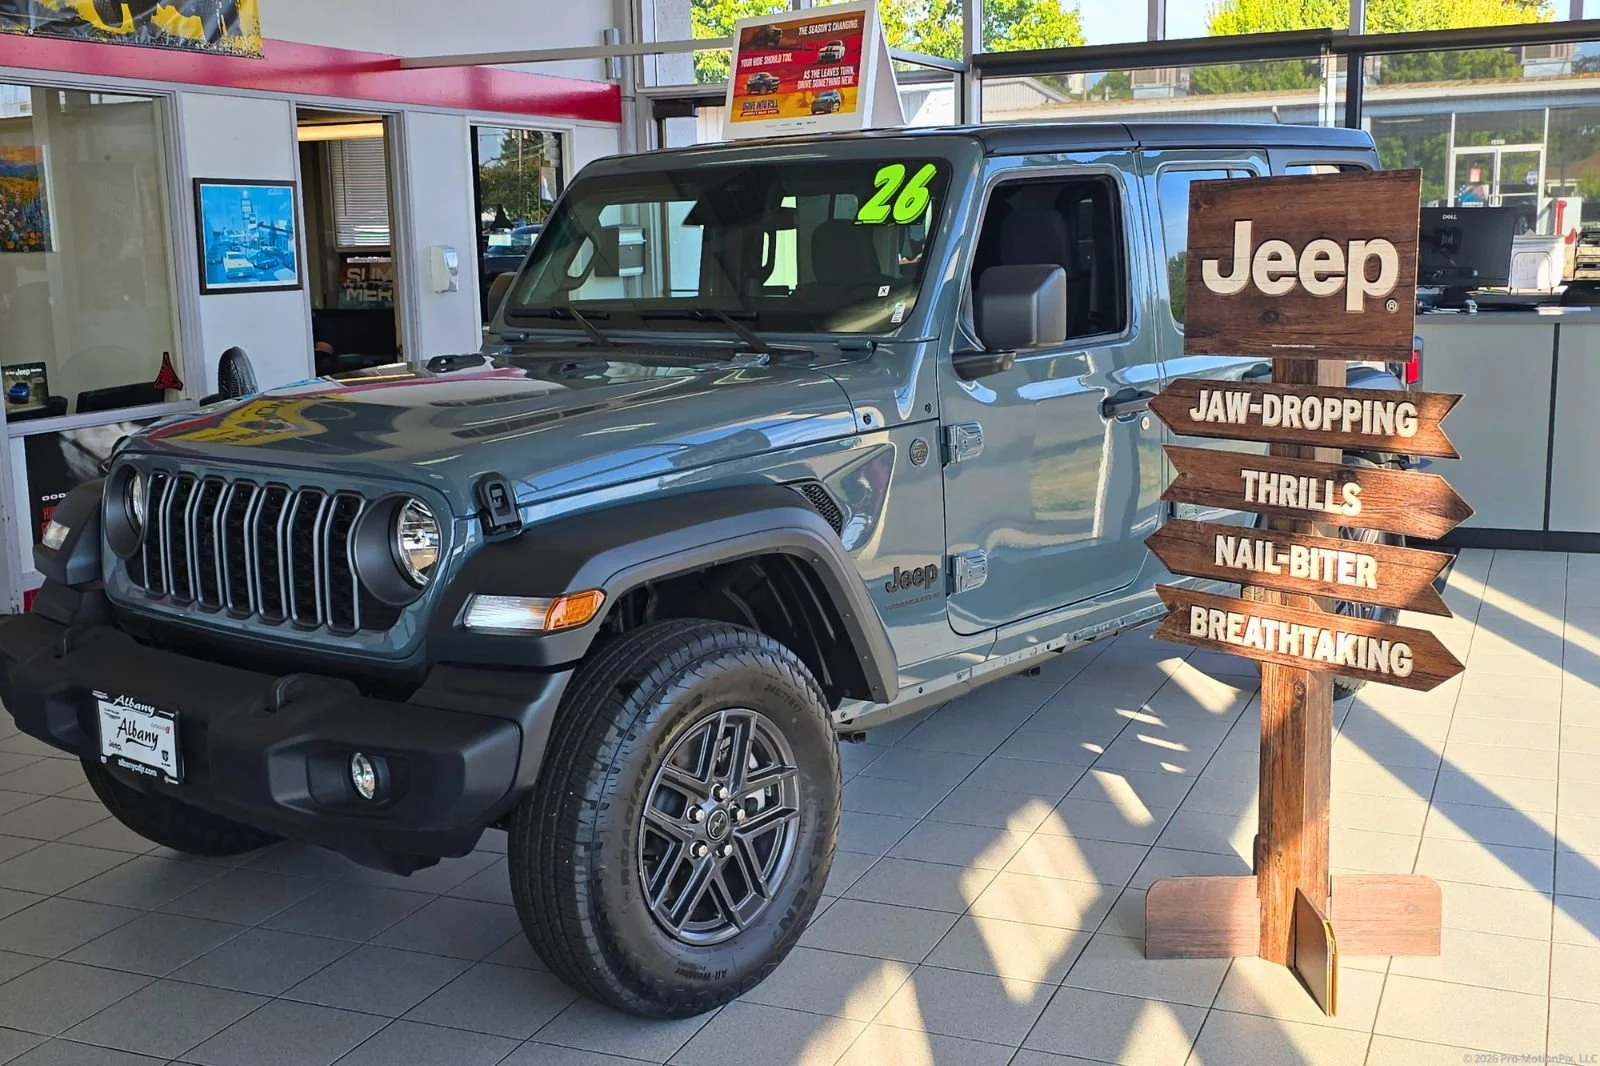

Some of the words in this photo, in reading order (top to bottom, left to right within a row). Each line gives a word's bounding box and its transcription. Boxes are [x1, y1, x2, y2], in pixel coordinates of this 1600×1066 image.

[799, 26, 808, 36] THE
[808, 23, 832, 34] SEASON'S
[741, 58, 752, 68] YOUR
[764, 54, 782, 65] SHOULD
[803, 70, 811, 79] AS
[811, 68, 821, 78] THE
[821, 66, 840, 77] LEAVES
[797, 80, 812, 90] DRIVE
[812, 76, 841, 88] SOMETHING
[857, 163, 937, 225] 26
[1201, 219, 1399, 314] Jeep
[1188, 389, 1418, 438] JAW-DROPPING
[41, 492, 69, 501] DOD
[1241, 469, 1361, 517] THRILLS
[1214, 533, 1378, 590] NAIL-BITER
[885, 563, 938, 593] Jeep
[1189, 604, 1414, 678] BREATHTAKING
[113, 694, 155, 717] Albany
[117, 717, 159, 751] Albany
